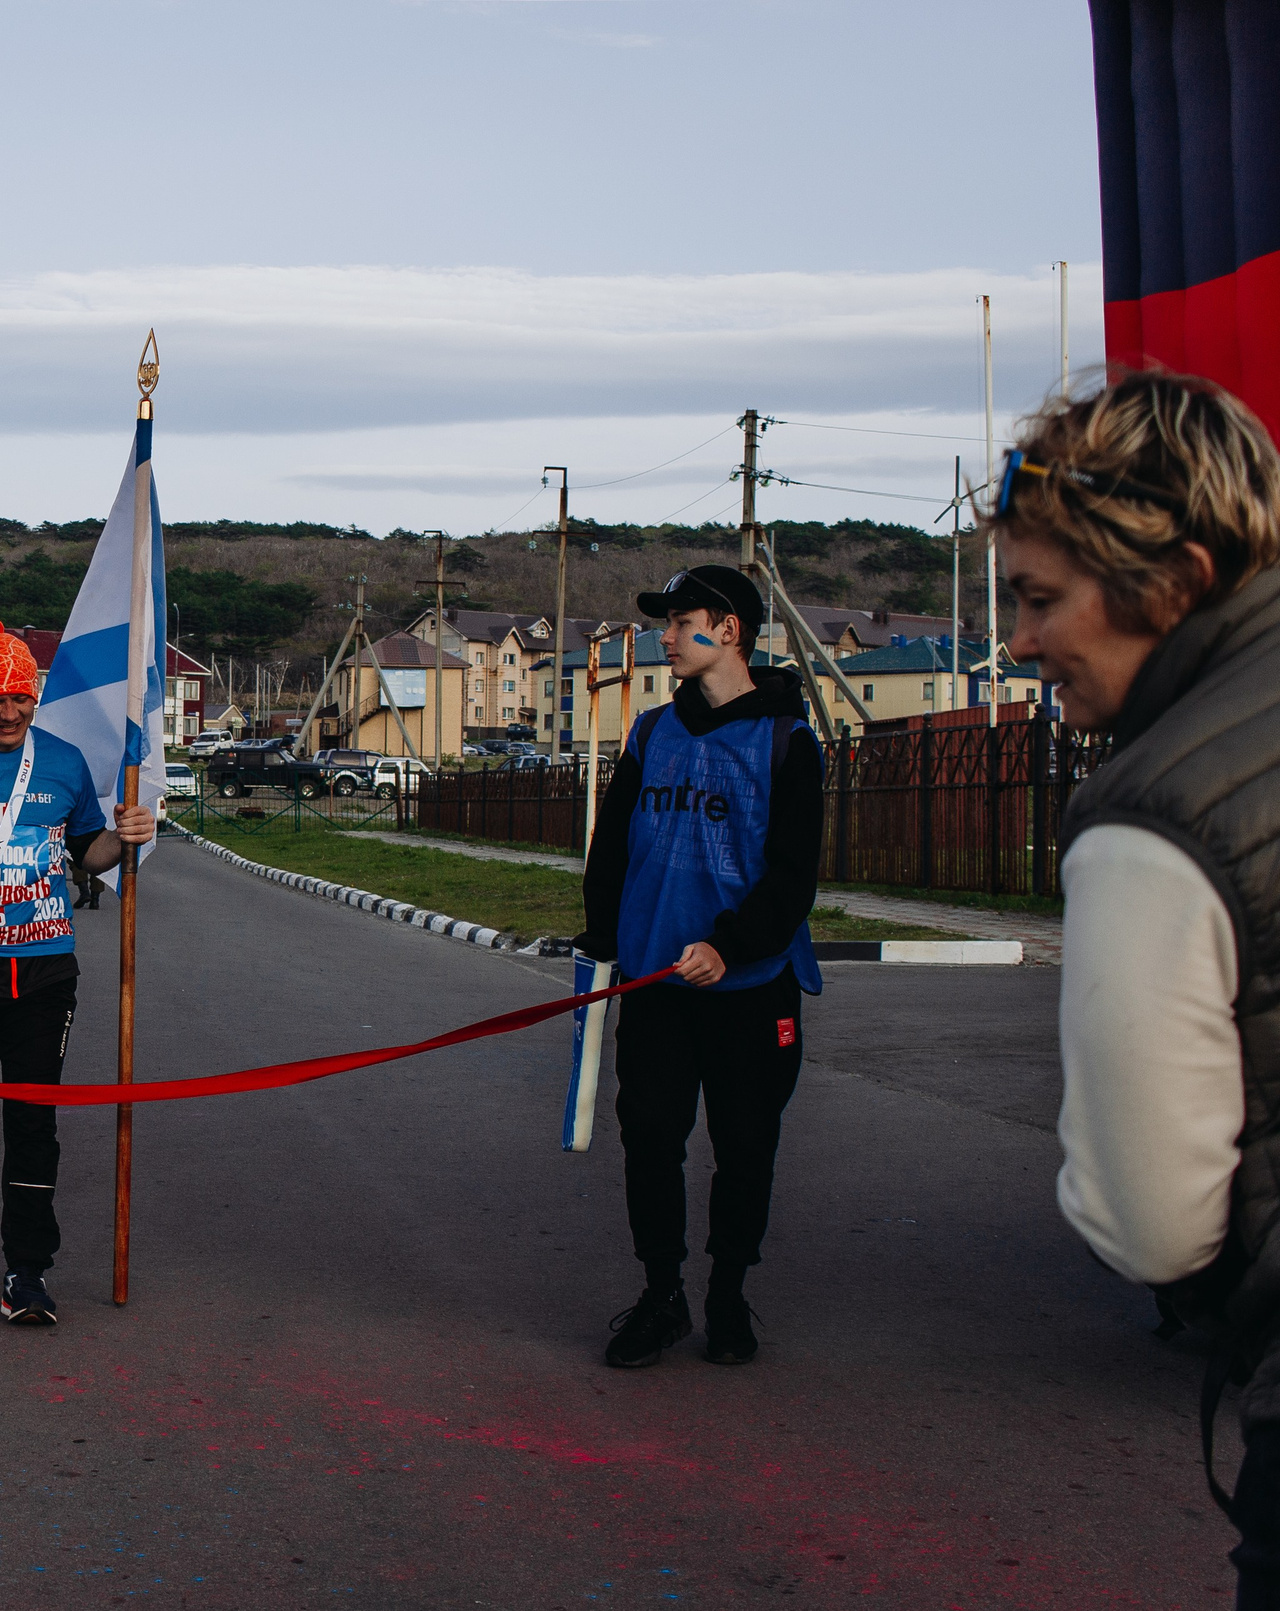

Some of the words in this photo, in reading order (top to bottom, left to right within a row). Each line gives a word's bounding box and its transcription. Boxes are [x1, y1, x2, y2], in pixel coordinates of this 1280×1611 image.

[20, 769, 28, 783] ПСБ
[640, 777, 730, 822] mitre
[2, 845, 37, 866] 004
[33, 895, 65, 921] 2024
